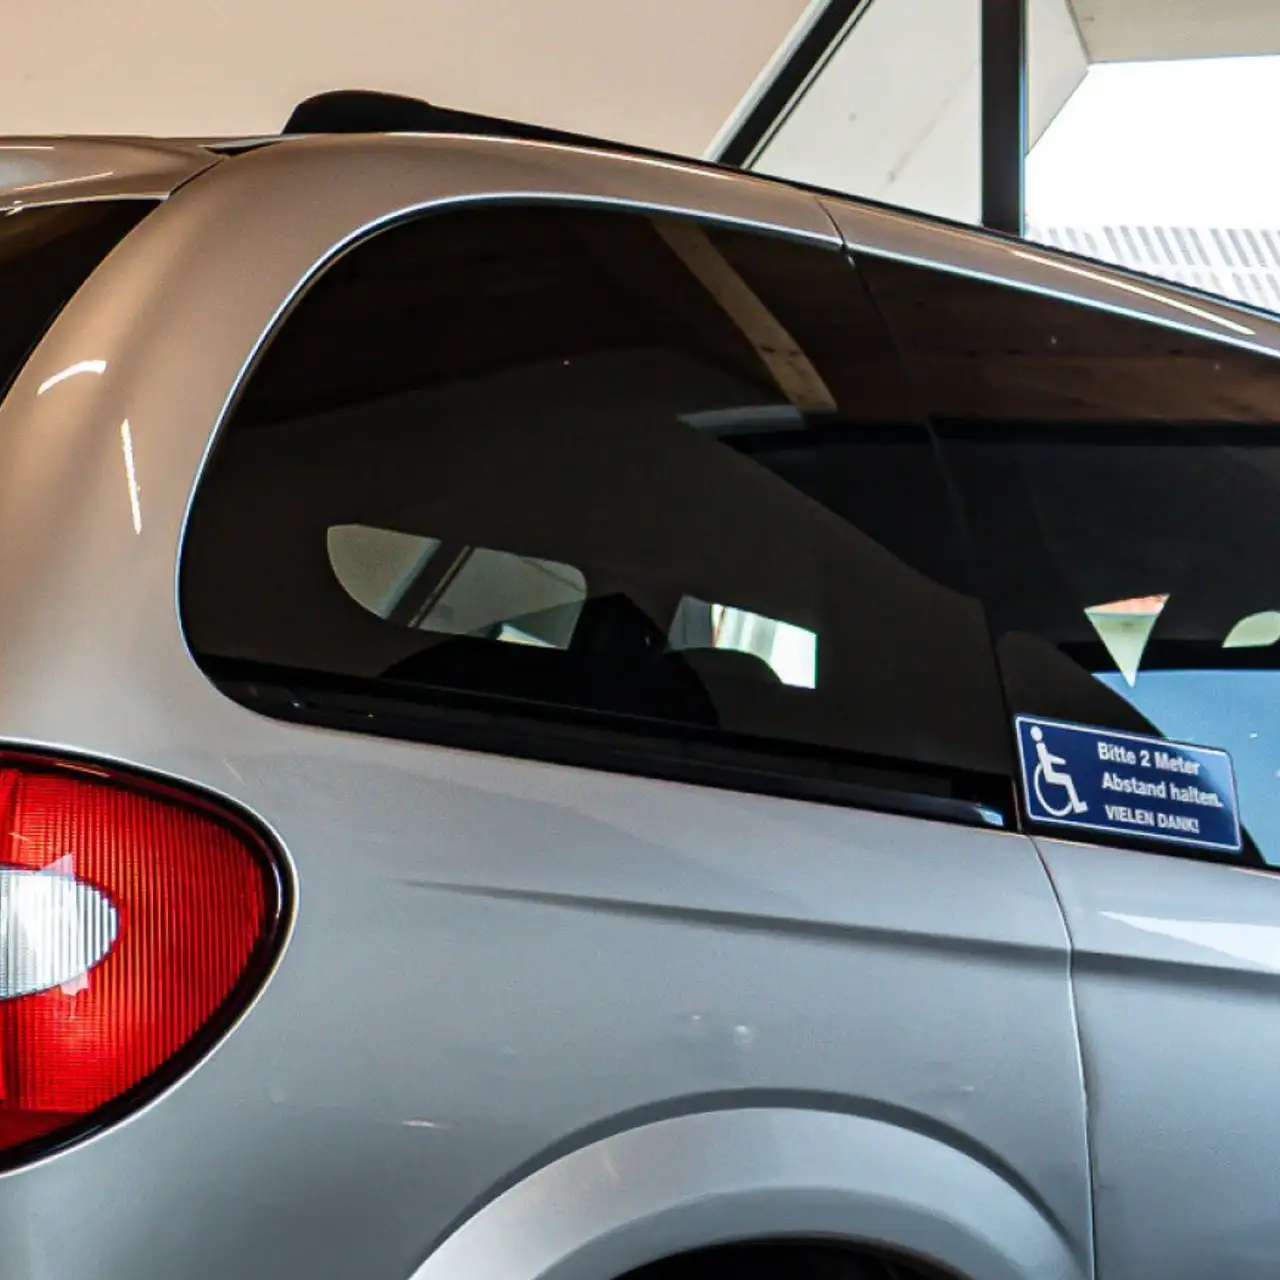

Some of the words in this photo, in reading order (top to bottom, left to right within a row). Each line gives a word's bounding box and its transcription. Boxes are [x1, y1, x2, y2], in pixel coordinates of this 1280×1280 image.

[1097, 742, 1136, 765] Bitte
[1140, 750, 1151, 768] 2
[1154, 752, 1200, 775] Meter
[1102, 771, 1166, 798] Abstand
[1169, 784, 1224, 808] halten.
[1105, 805, 1154, 826] VIELEN
[1157, 813, 1200, 834] DANK!
